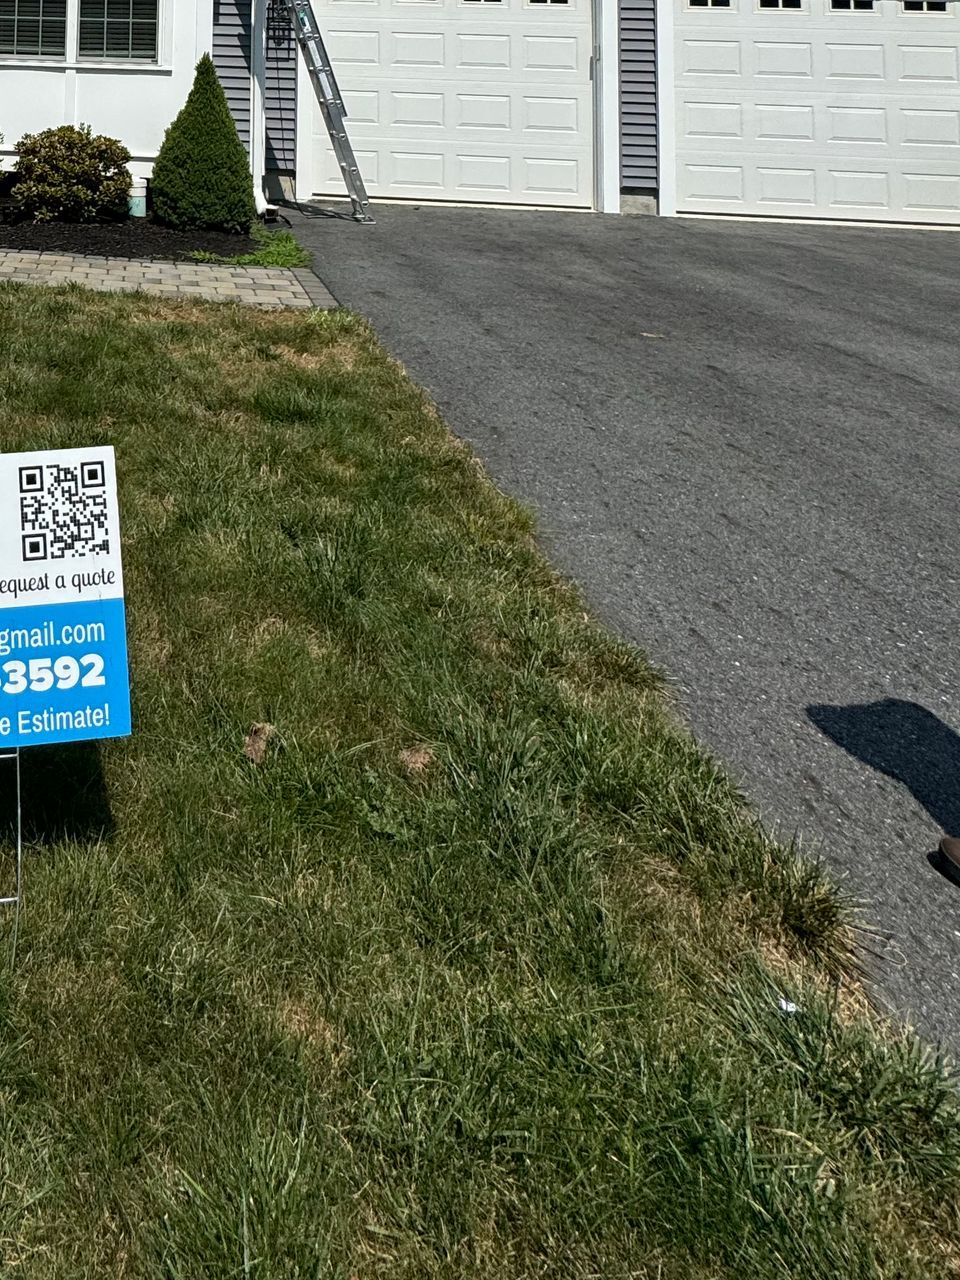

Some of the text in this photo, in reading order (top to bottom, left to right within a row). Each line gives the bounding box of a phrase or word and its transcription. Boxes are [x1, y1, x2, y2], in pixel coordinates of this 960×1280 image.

[55, 575, 66, 588] a
[71, 568, 115, 593] quote
[18, 703, 110, 734] Estimate!
